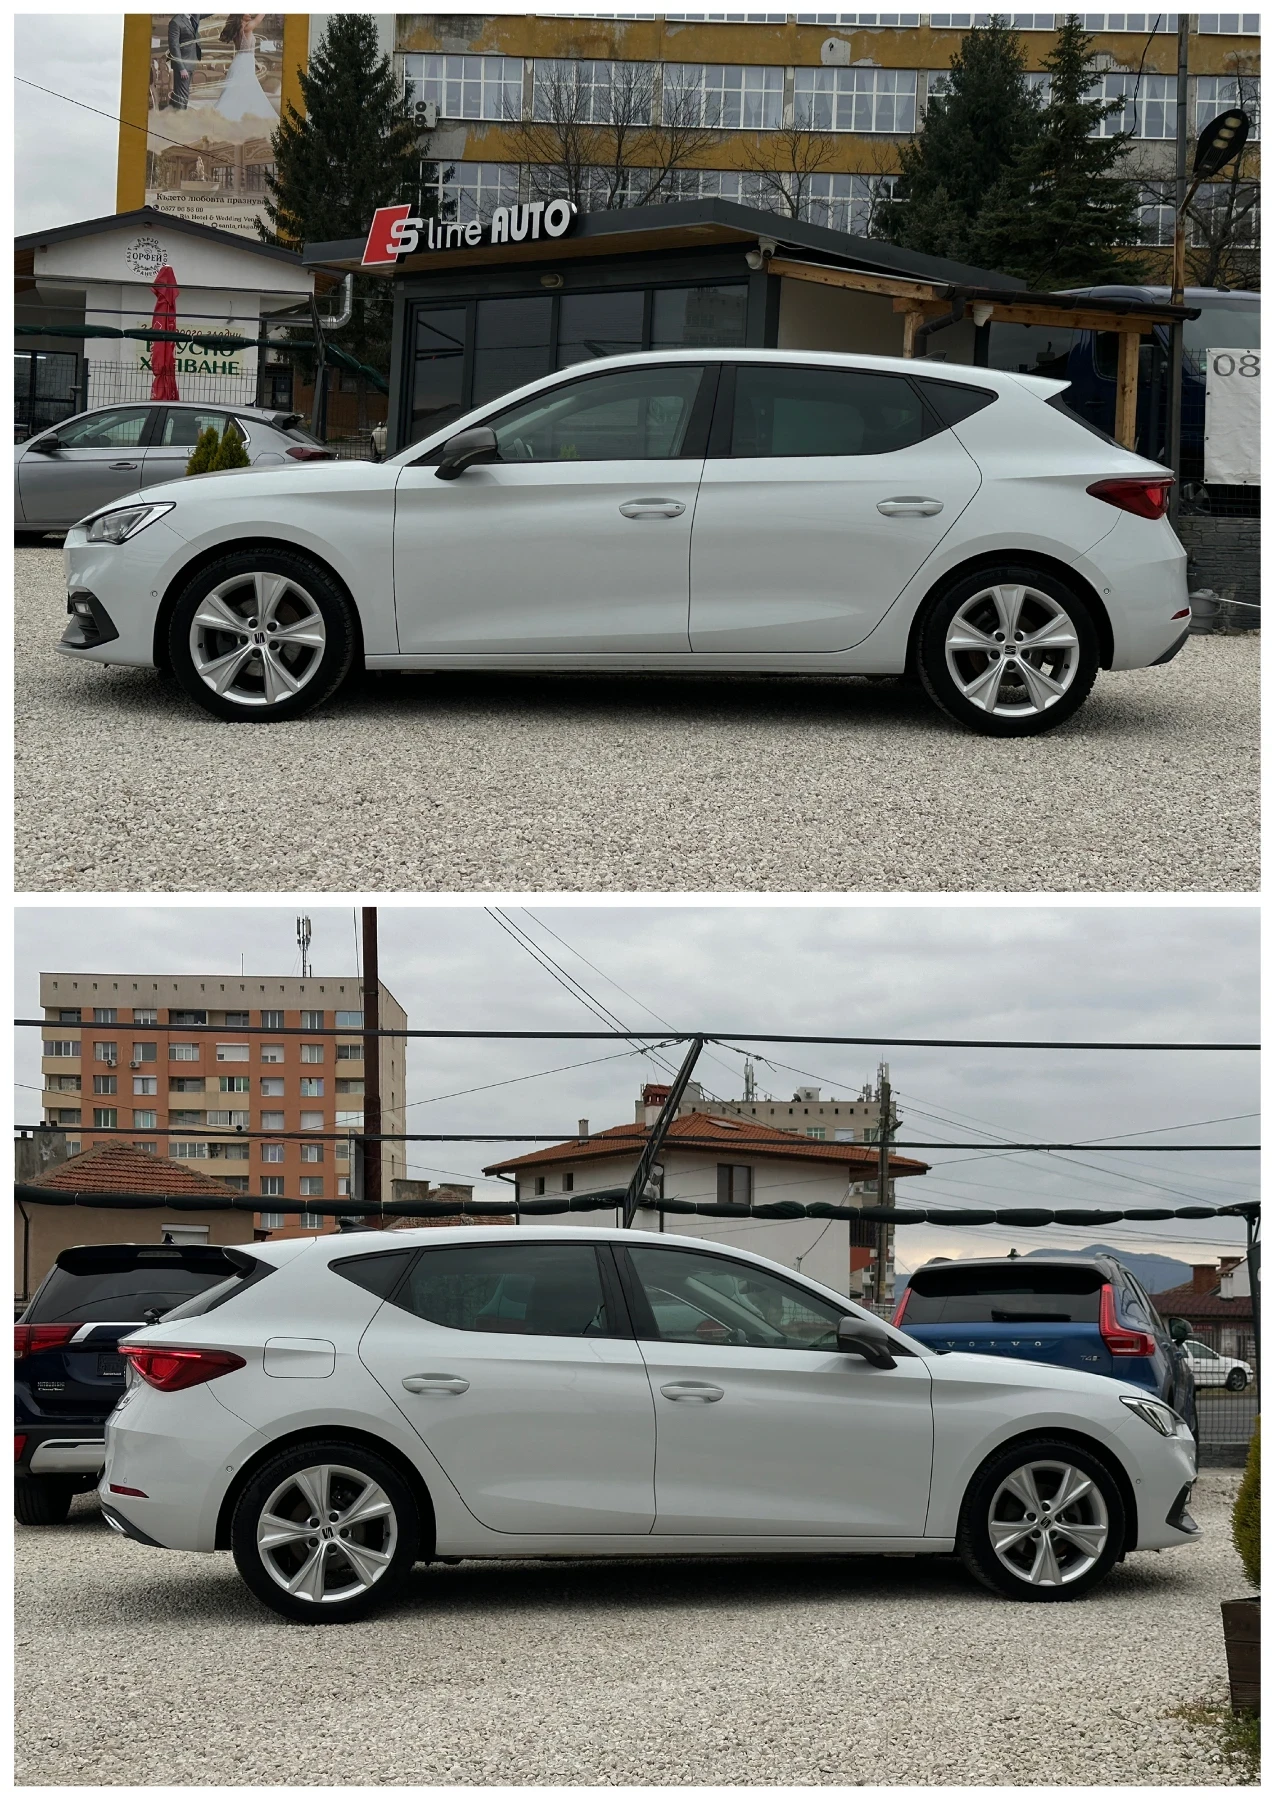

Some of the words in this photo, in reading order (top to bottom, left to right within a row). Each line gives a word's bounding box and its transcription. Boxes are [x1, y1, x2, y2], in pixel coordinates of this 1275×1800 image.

[156, 193, 186, 202] Където
[188, 195, 225, 204] любовта
[215, 215, 242, 223] Wedding
[386, 217, 424, 254] S
[428, 217, 481, 249] line
[491, 199, 571, 244] AUTO
[140, 356, 240, 375] ХПВАНЕ
[1213, 354, 1260, 377] 08
